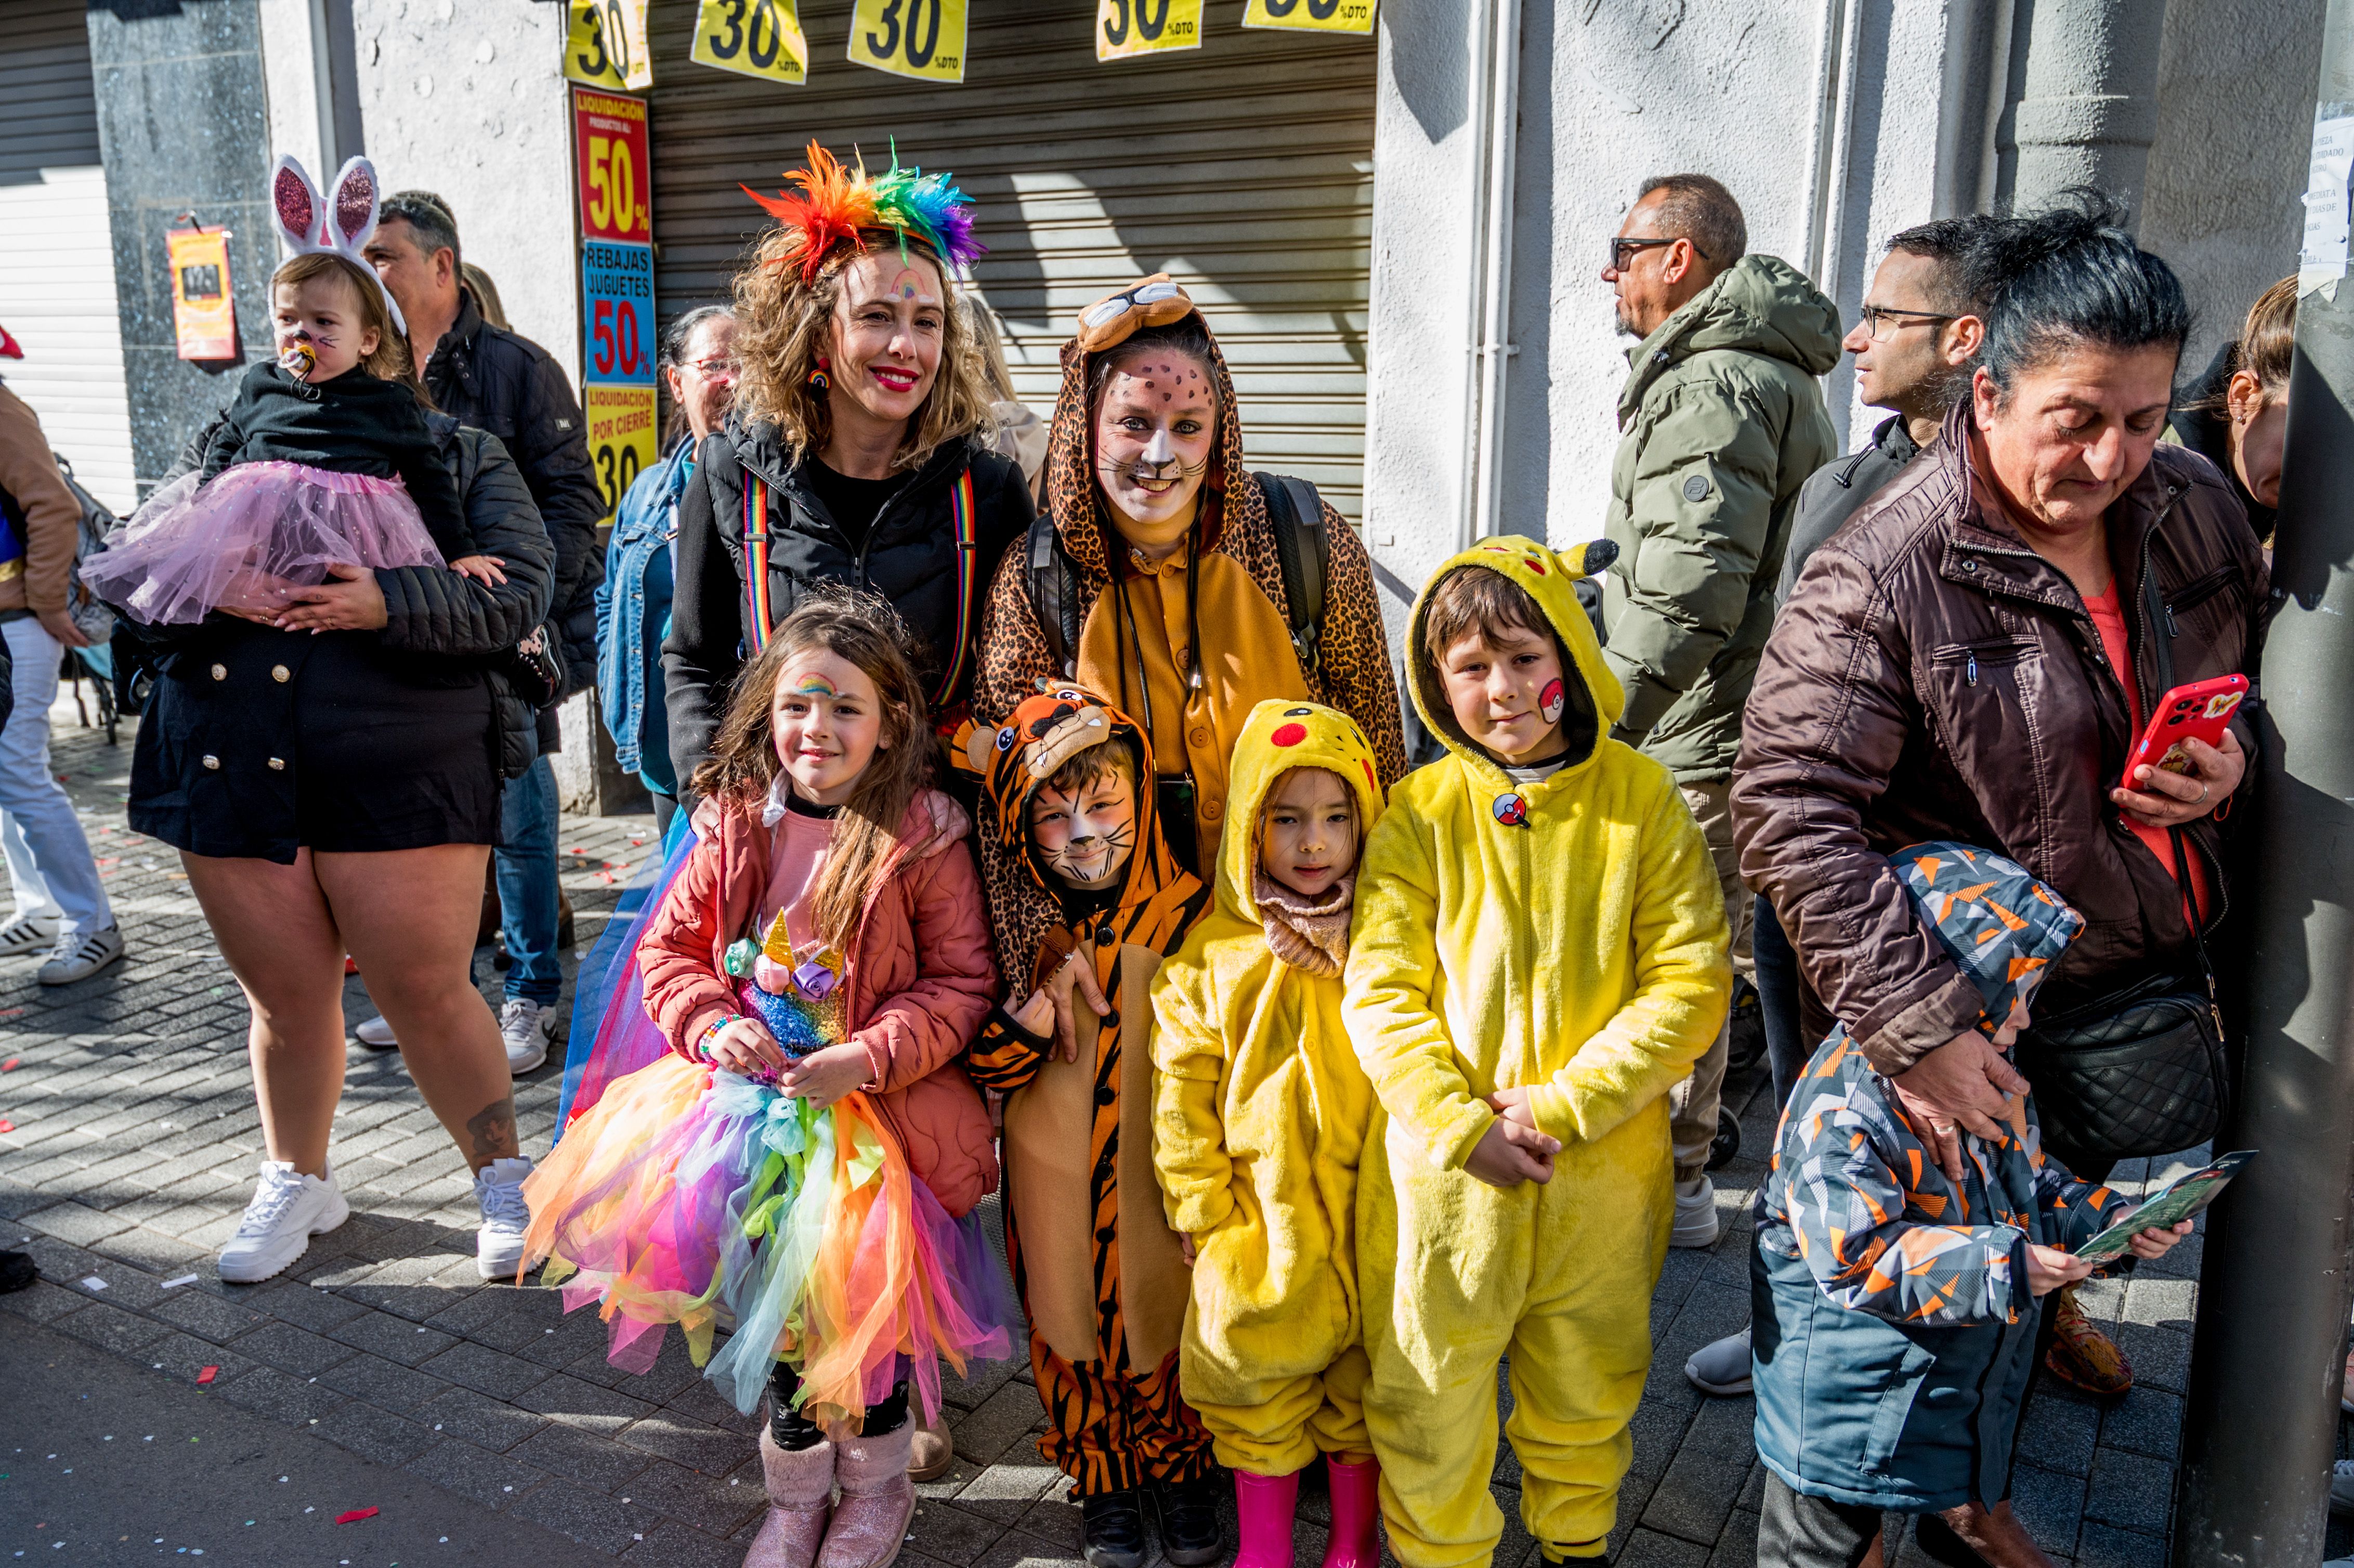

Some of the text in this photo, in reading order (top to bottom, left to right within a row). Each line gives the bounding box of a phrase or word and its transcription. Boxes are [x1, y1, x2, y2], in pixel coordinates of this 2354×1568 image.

[1340, 6, 1367, 19] %DTO
[578, 0, 629, 79] 30
[710, 0, 780, 68] 30
[866, 0, 958, 69] 30 %DTO
[1168, 22, 1193, 36] %DTO
[577, 93, 645, 121] LIQUIDACIÓN
[587, 247, 648, 272] REBAJAS
[589, 273, 649, 297] JUGUETES
[590, 389, 652, 407] LIQUIDACIÓN
[593, 409, 651, 442] POR CIERRE
[597, 444, 639, 517] 30
